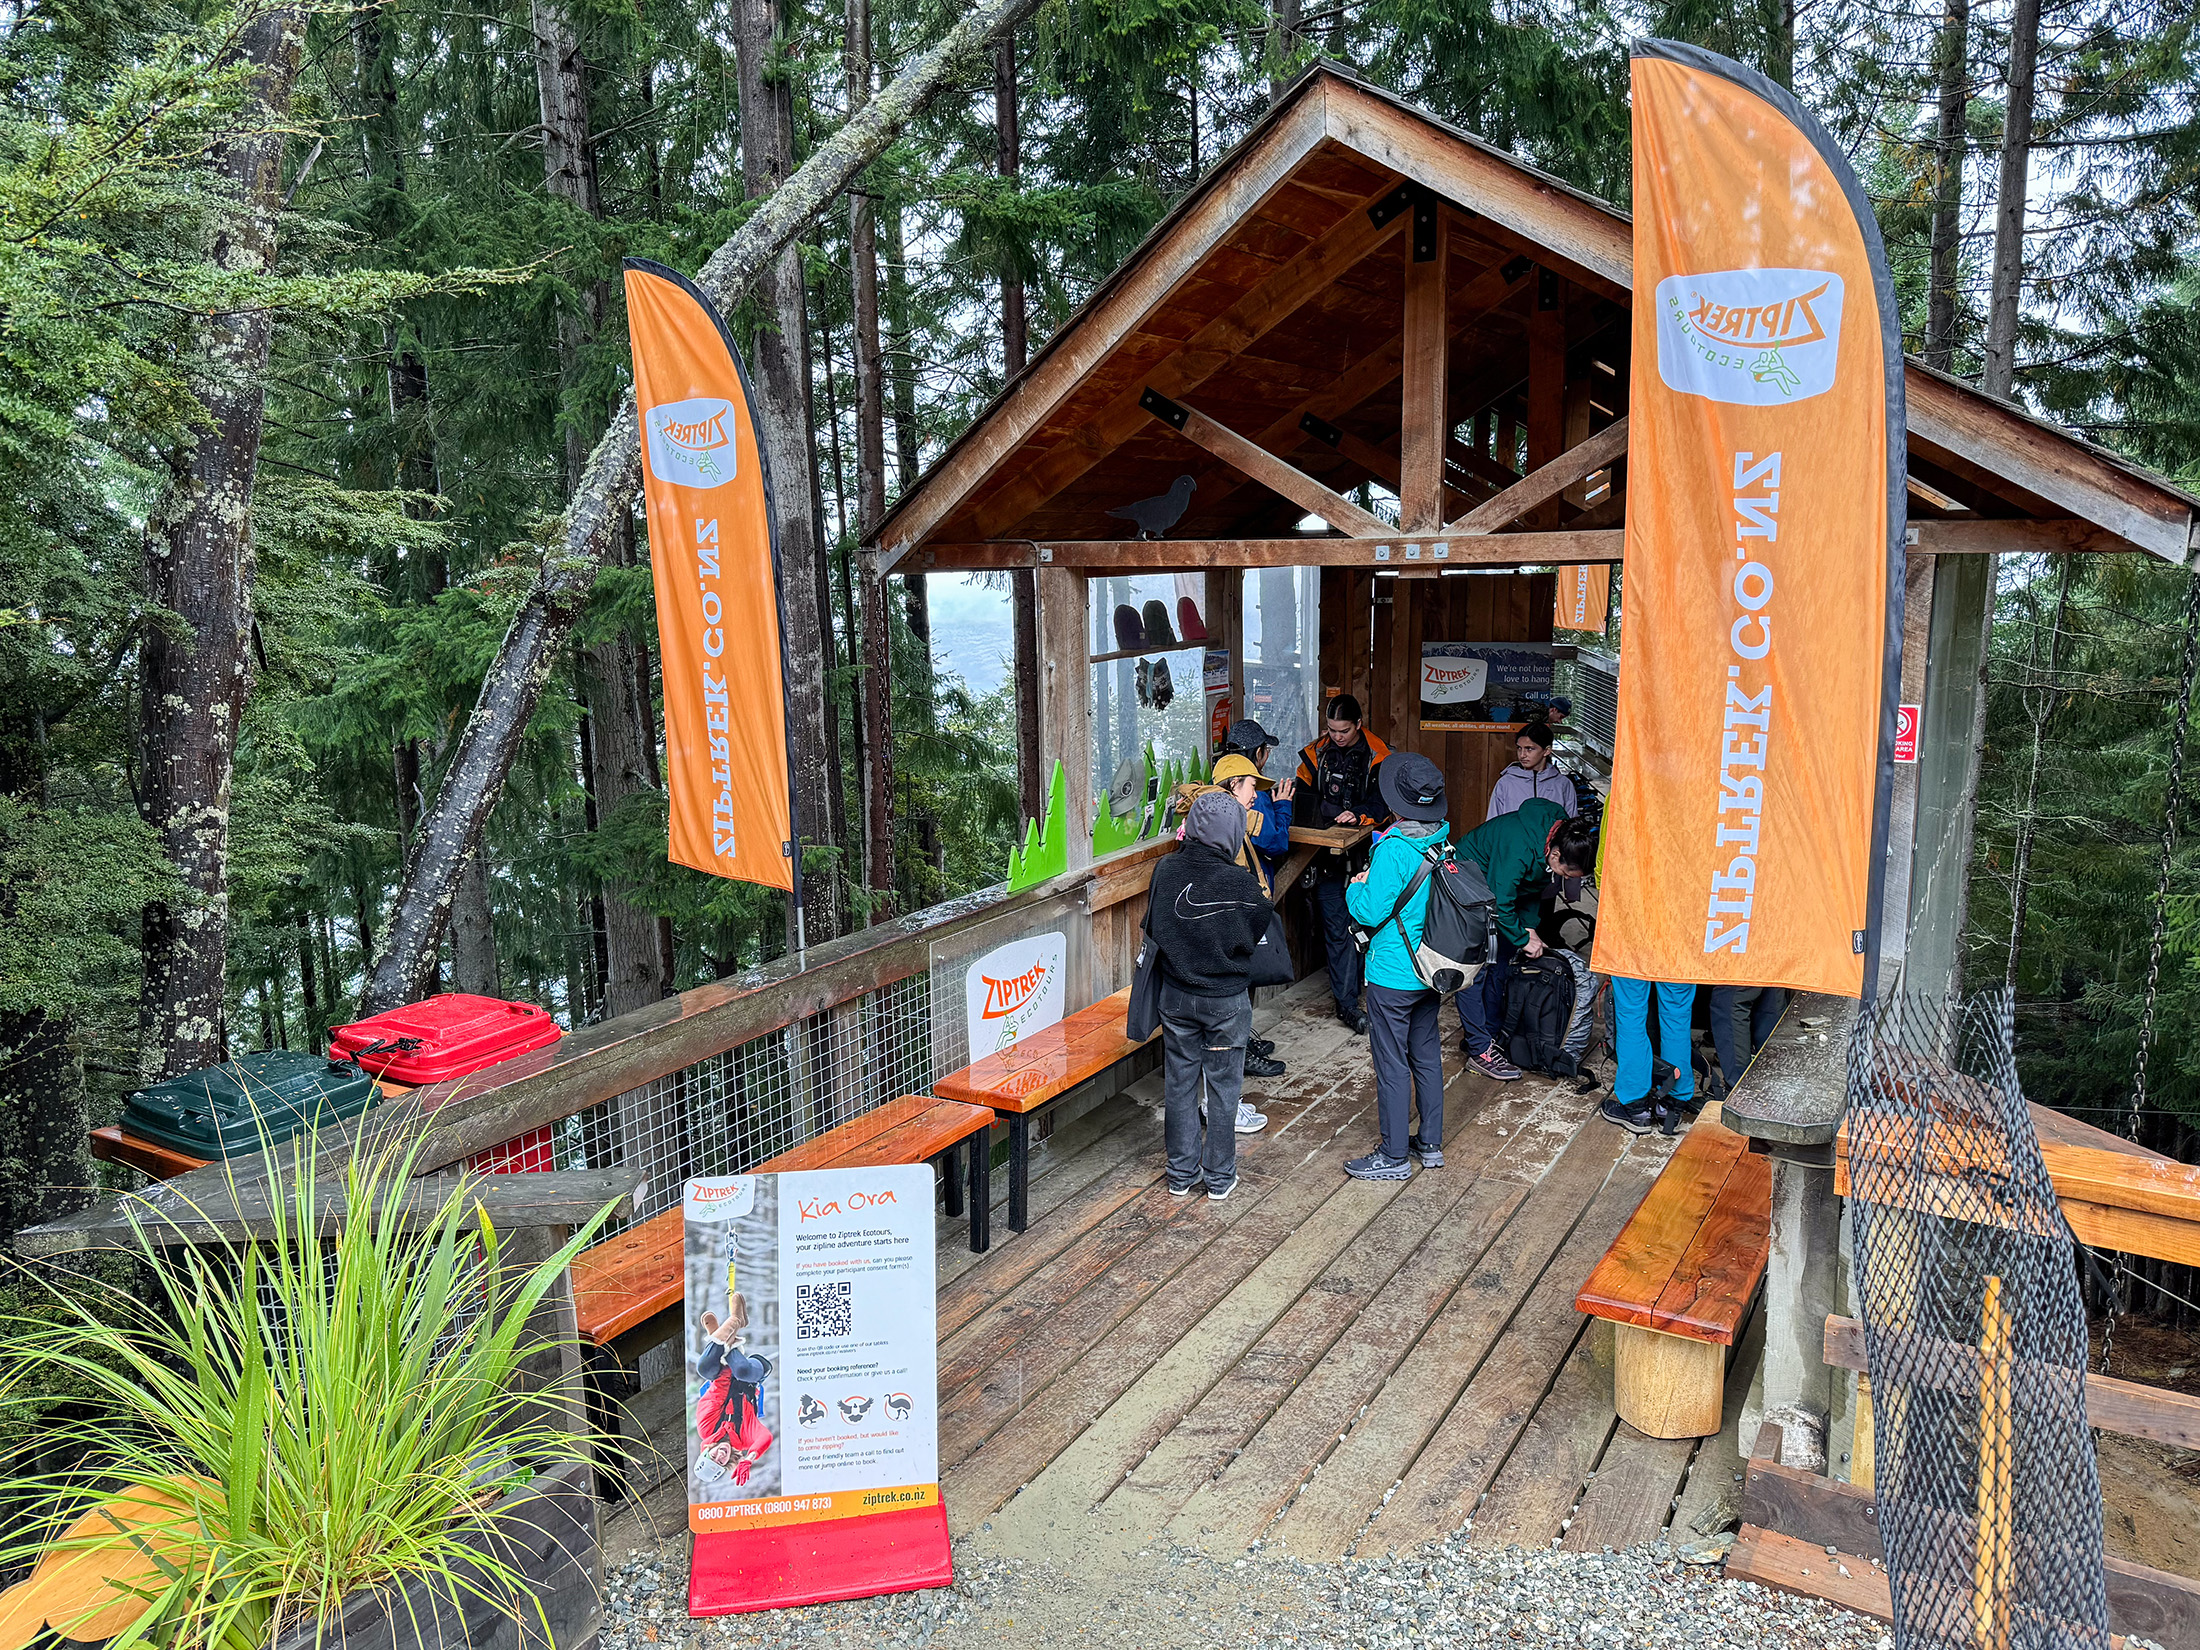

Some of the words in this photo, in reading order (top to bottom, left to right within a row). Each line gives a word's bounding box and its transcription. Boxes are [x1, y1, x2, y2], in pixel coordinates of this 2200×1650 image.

[1424, 664, 1470, 684] ZIPTREK
[1450, 668, 1480, 691] ECOTOURS
[1532, 675, 1550, 684] hang
[982, 958, 1046, 1020] ZIPTREK
[1020, 954, 1057, 1024] ECOTOURS
[692, 1182, 739, 1202] ZIPTREK
[798, 1197, 842, 1223] Kia
[848, 1190, 897, 1210] Ora
[838, 1230, 860, 1240] Ziptrek
[796, 1244, 810, 1253] your
[814, 1242, 835, 1251] zipline
[838, 1240, 872, 1248] adventure
[837, 1267, 865, 1275] participant
[827, 1365, 849, 1373] booking
[828, 1371, 862, 1380] confirmation
[863, 1491, 925, 1506] ziptrek.co.nz
[698, 1507, 722, 1520] 0800
[725, 1503, 762, 1518] ZIPTREK
[764, 1500, 791, 1516] (0800
[793, 1498, 810, 1512] 947
[812, 1496, 831, 1510] 873)
